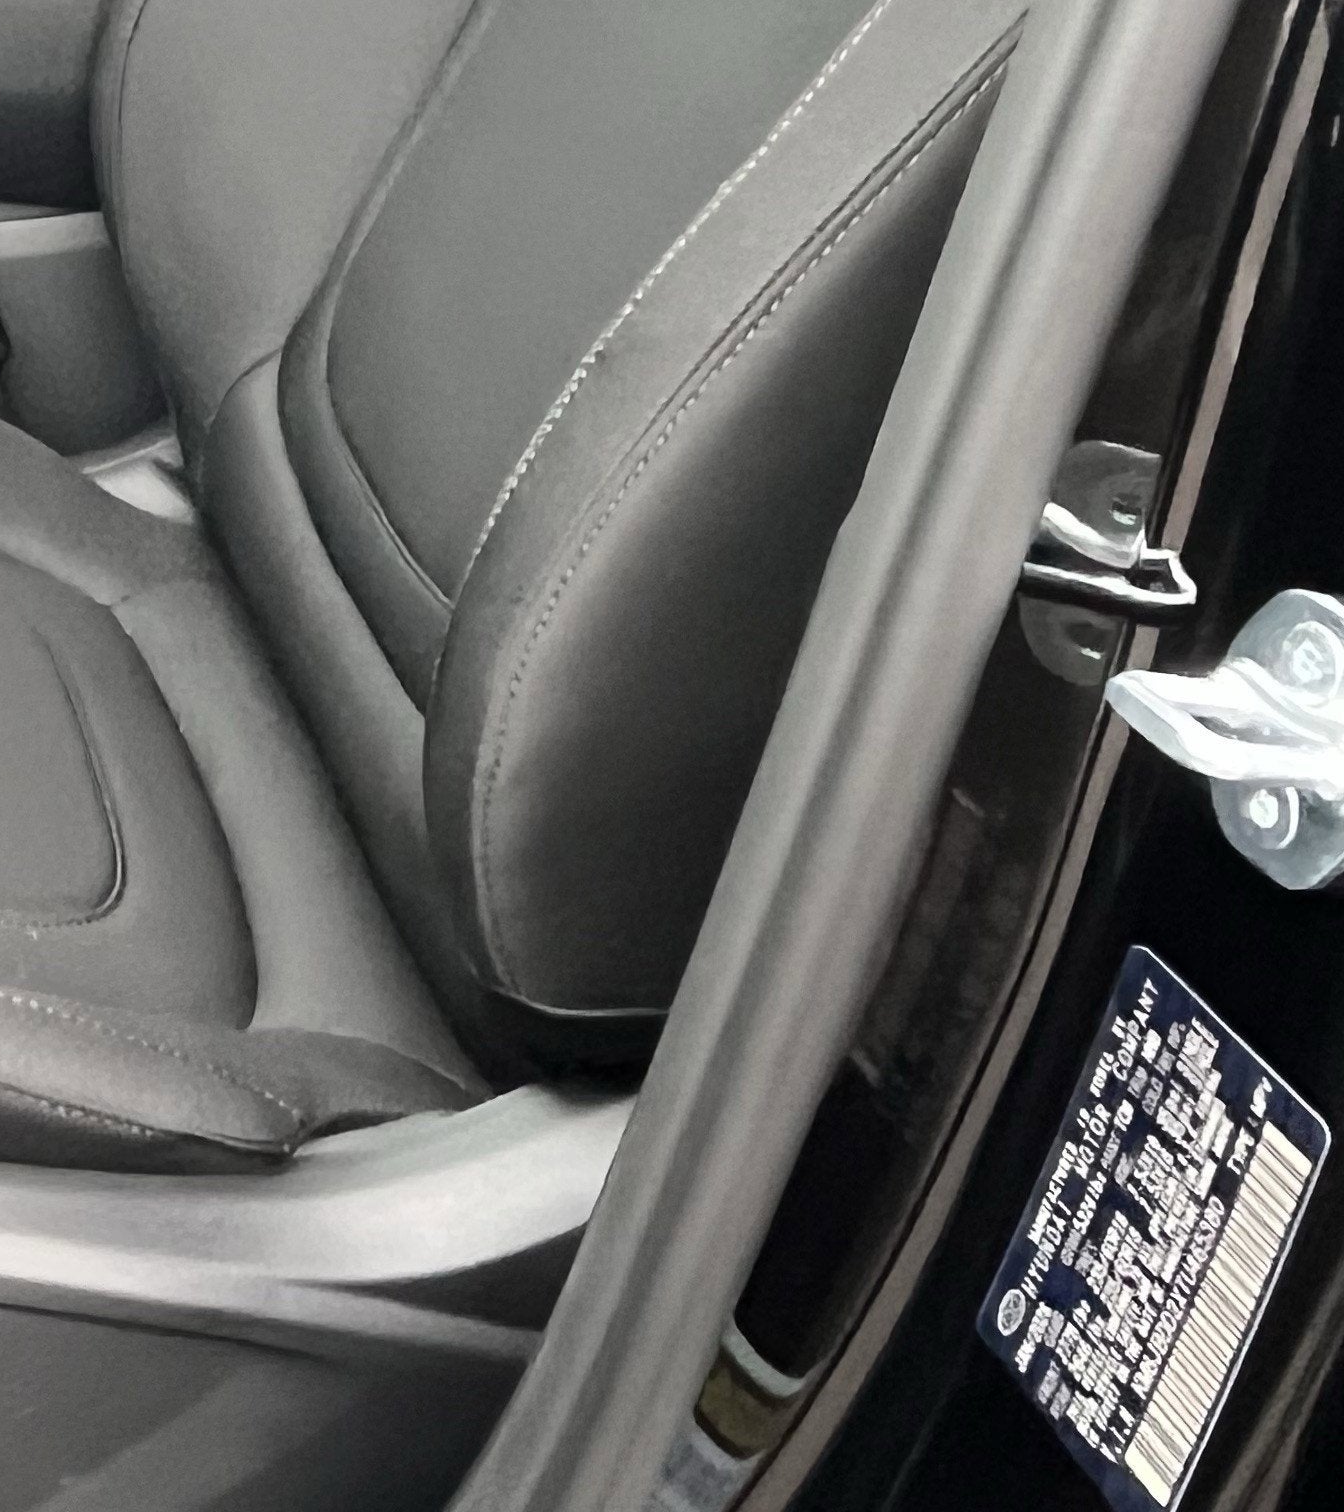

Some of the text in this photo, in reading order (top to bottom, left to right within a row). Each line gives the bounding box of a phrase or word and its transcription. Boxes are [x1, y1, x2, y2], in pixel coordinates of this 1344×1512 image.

[1021, 1196, 1072, 1300] HYUNDAI
[1071, 1101, 1112, 1180] MOTOR
[1109, 977, 1162, 1083] COMPANY
